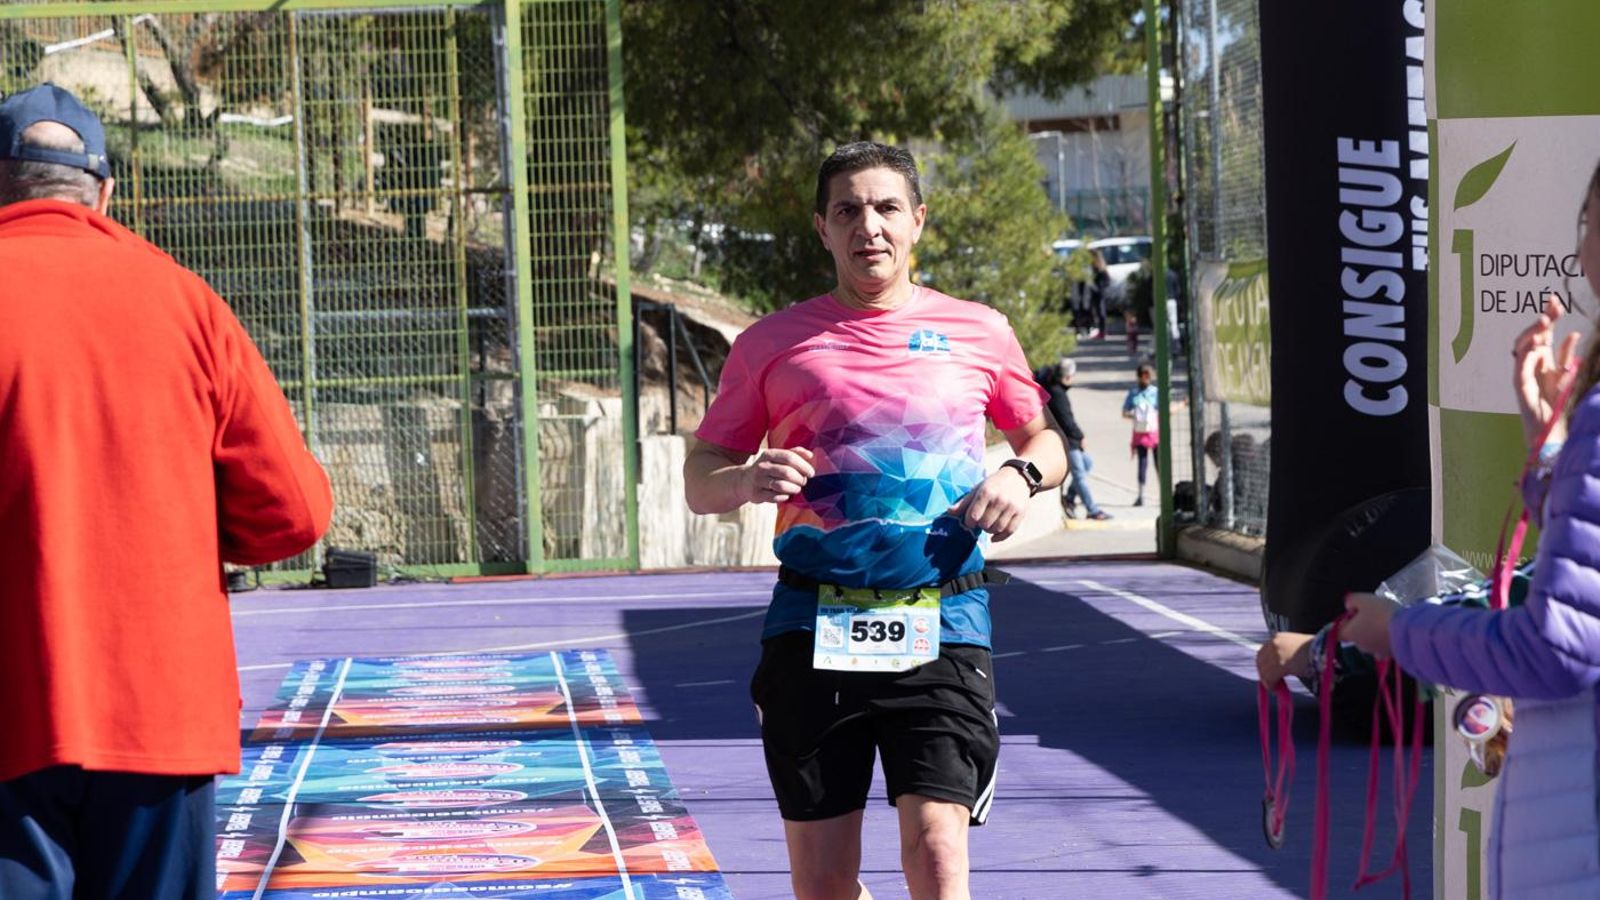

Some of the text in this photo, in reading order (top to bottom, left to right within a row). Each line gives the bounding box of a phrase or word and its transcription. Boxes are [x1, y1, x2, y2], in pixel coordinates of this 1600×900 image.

[1337, 137, 1409, 416] CONSIGUE
[1481, 286, 1572, 314] DE JAÉN
[851, 620, 906, 642] 539
